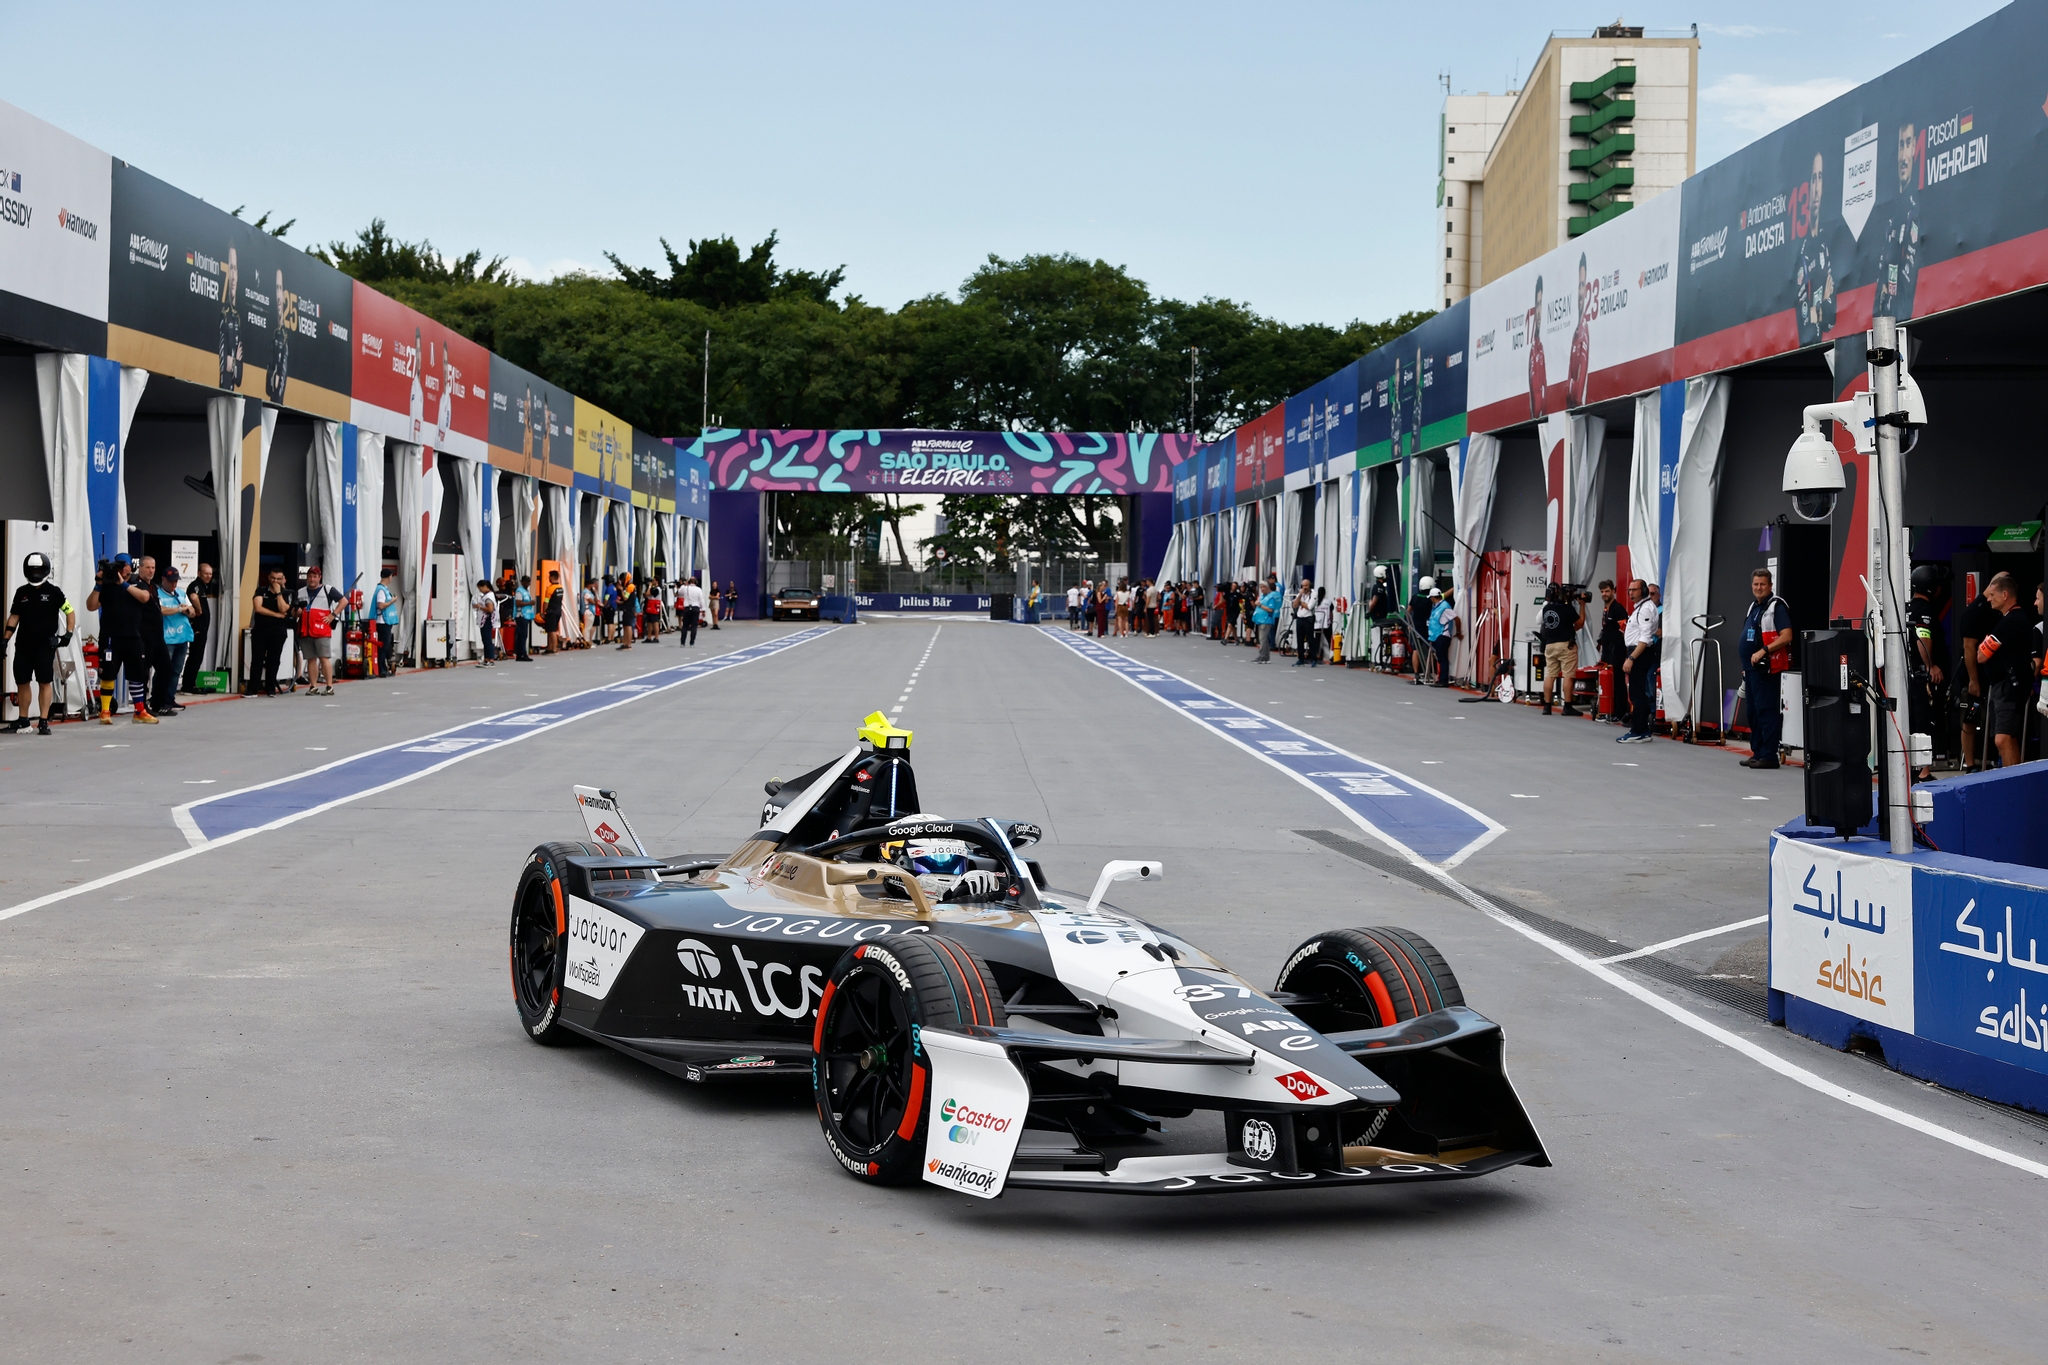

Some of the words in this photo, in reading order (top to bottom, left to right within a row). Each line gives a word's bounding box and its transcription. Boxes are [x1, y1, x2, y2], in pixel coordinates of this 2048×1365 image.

[1928, 114, 1958, 148] Pascal
[1914, 129, 1926, 190] 1
[1927, 134, 1988, 186] WEHRLEIN
[1747, 200, 1772, 227] António
[1772, 194, 1786, 217] Félix
[1788, 182, 1810, 240] 13
[1845, 190, 1873, 208] PORSCHE
[66, 212, 98, 242] Hankook
[1746, 233, 1757, 258] DA
[1758, 222, 1784, 254] COSTA
[194, 250, 220, 276] Maximilian
[190, 271, 219, 301] GÜNTHER
[220, 261, 229, 304] 7
[284, 290, 298, 332] 25
[1547, 294, 1572, 324] NISSAN
[1584, 278, 1600, 322] 23
[1600, 289, 1628, 316] ROWLAND
[248, 312, 266, 328] PENSKE
[1525, 307, 1536, 346] 17
[1512, 332, 1524, 350] NATO
[406, 346, 416, 378] 27
[912, 440, 926, 448] ABB
[926, 440, 962, 448] FORMULA
[880, 451, 928, 471] SÃO
[932, 453, 1010, 472] PAULO.
[900, 468, 985, 488] ELECTRIC.
[181, 564, 188, 574] 7
[856, 596, 874, 606] Bär
[900, 596, 930, 608] Julius
[932, 597, 952, 607] Bär
[888, 824, 924, 836] Google
[926, 823, 954, 833] Cloud
[1793, 864, 1886, 938] سابك
[568, 960, 600, 986] Wolfspeed
[864, 945, 912, 992] Hankook
[1816, 944, 1886, 1006] sabic
[682, 984, 742, 1013] TATA
[1174, 984, 1252, 1002] 37
[1204, 1008, 1256, 1020] Google
[1242, 1020, 1310, 1036] ABB
[686, 1072, 700, 1081] AERO
[956, 1106, 1012, 1133] Castrol
[826, 1129, 868, 1176] Hankook
[1244, 1126, 1272, 1152] FIA
[936, 1162, 997, 1190] Hankook
